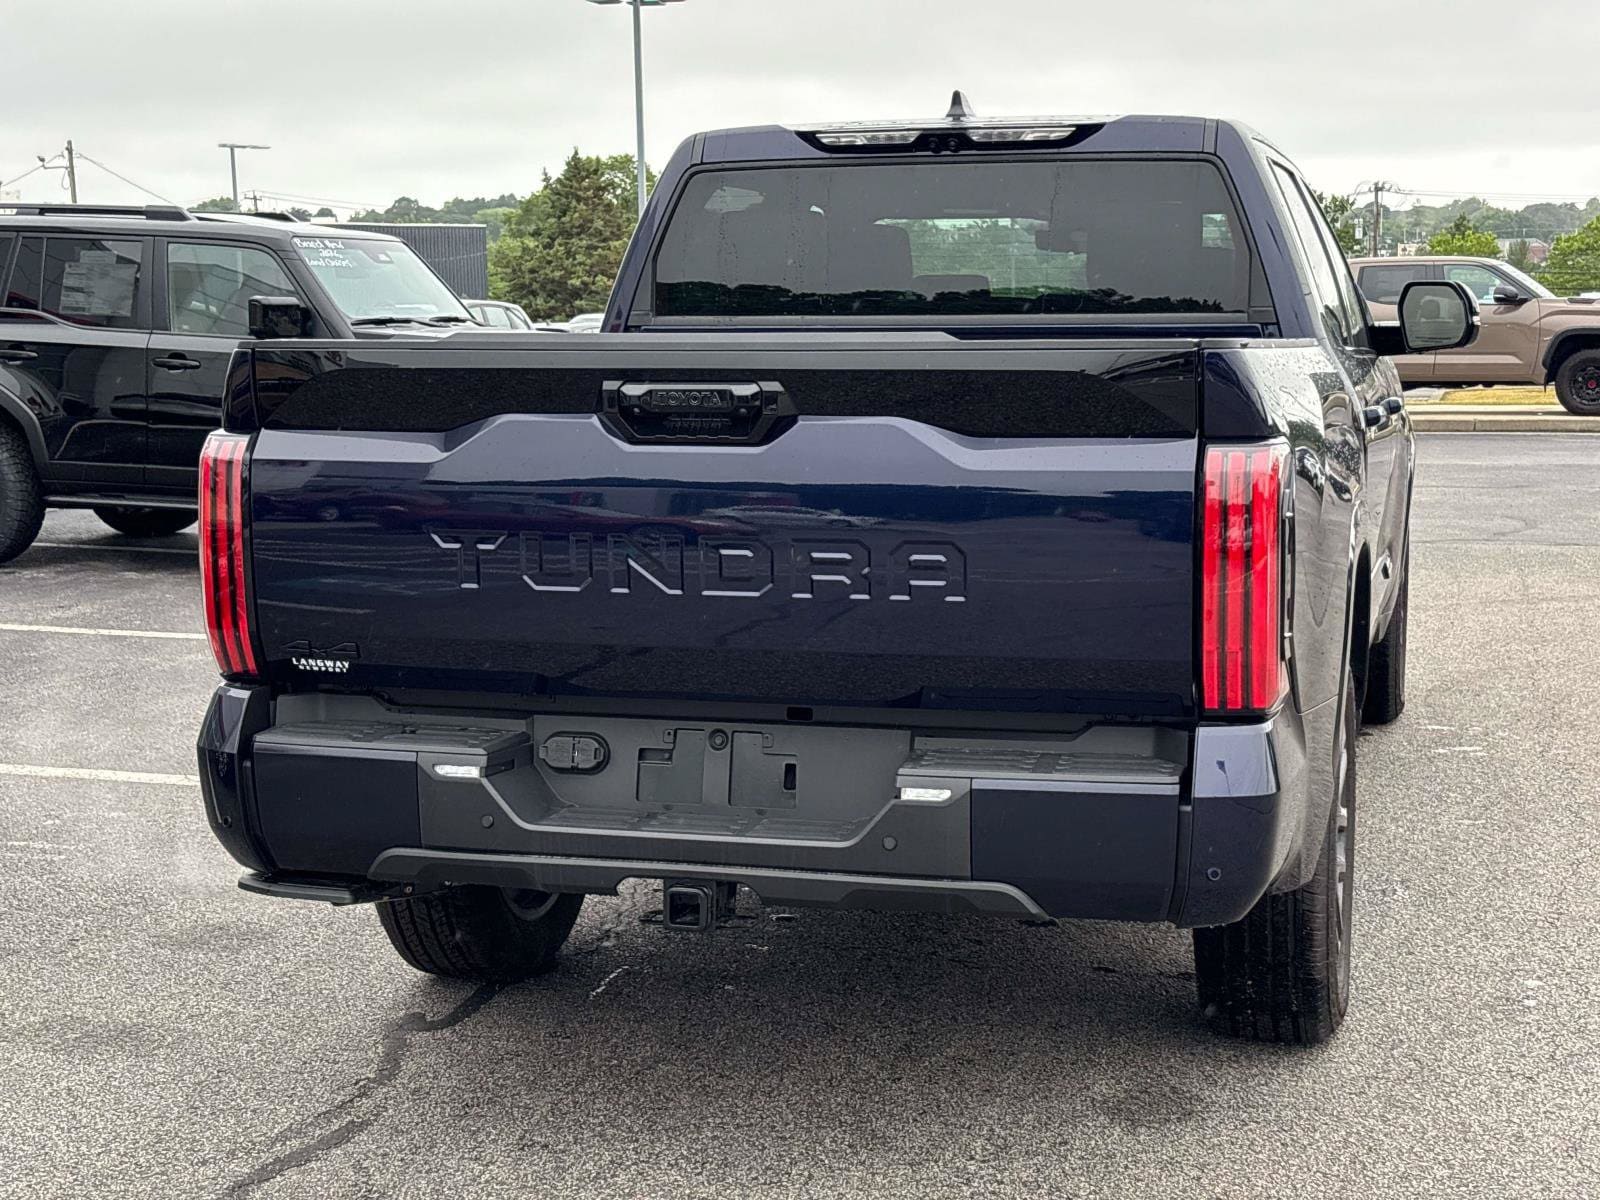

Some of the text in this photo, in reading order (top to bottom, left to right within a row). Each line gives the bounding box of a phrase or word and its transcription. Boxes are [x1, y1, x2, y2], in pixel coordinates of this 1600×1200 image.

[657, 391, 722, 406] TOYOTA
[428, 530, 968, 602] TUNDRA
[292, 657, 350, 669] LANGWAY
